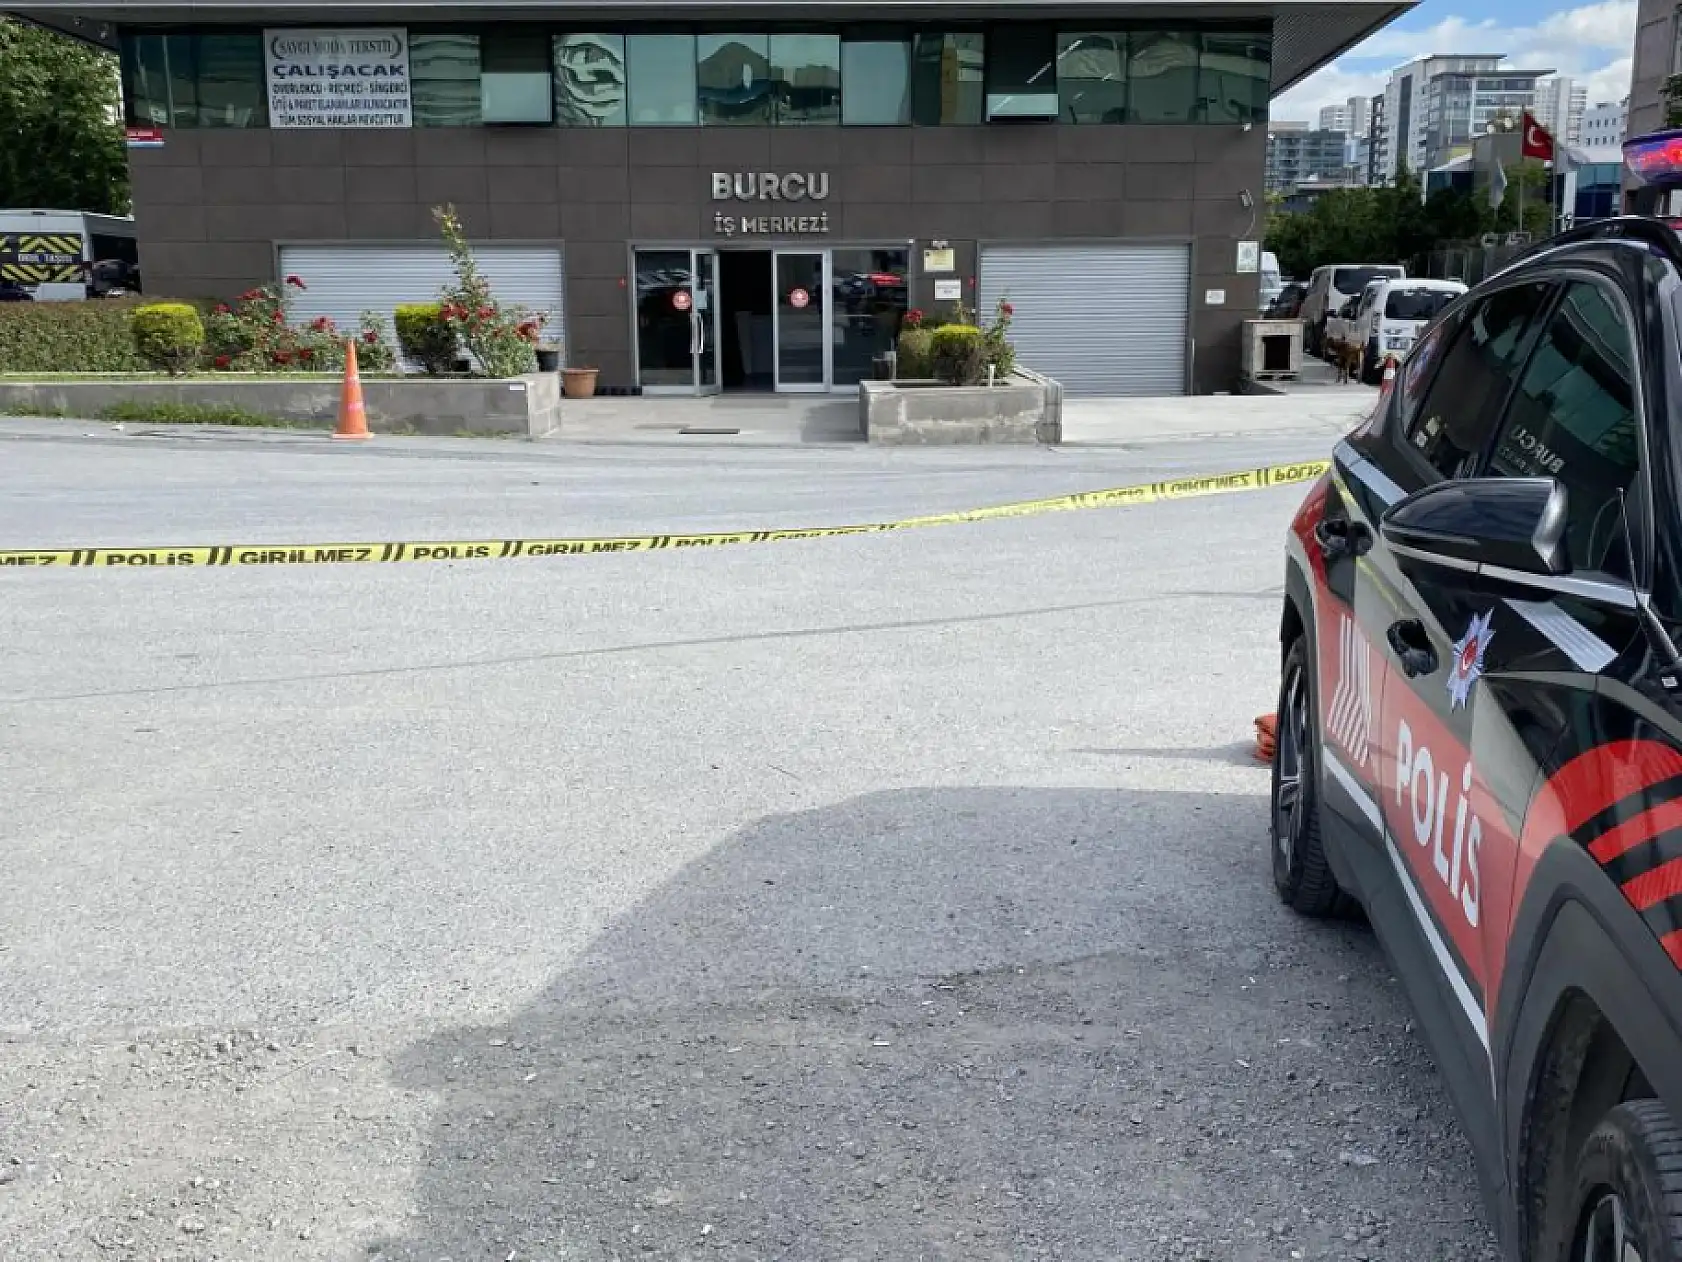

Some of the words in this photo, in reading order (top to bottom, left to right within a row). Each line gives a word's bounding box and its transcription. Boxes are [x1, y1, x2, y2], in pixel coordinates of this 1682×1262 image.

[273, 64, 404, 79] ÇALIŞACAK
[711, 172, 829, 200] BURCU
[714, 210, 737, 237] İŞ
[741, 210, 829, 233] MERKEZİ
[106, 552, 194, 565] POLİS
[239, 548, 372, 564] GİRİLMEZ
[414, 546, 490, 559] POLİS
[1396, 718, 1482, 928] POLİS
